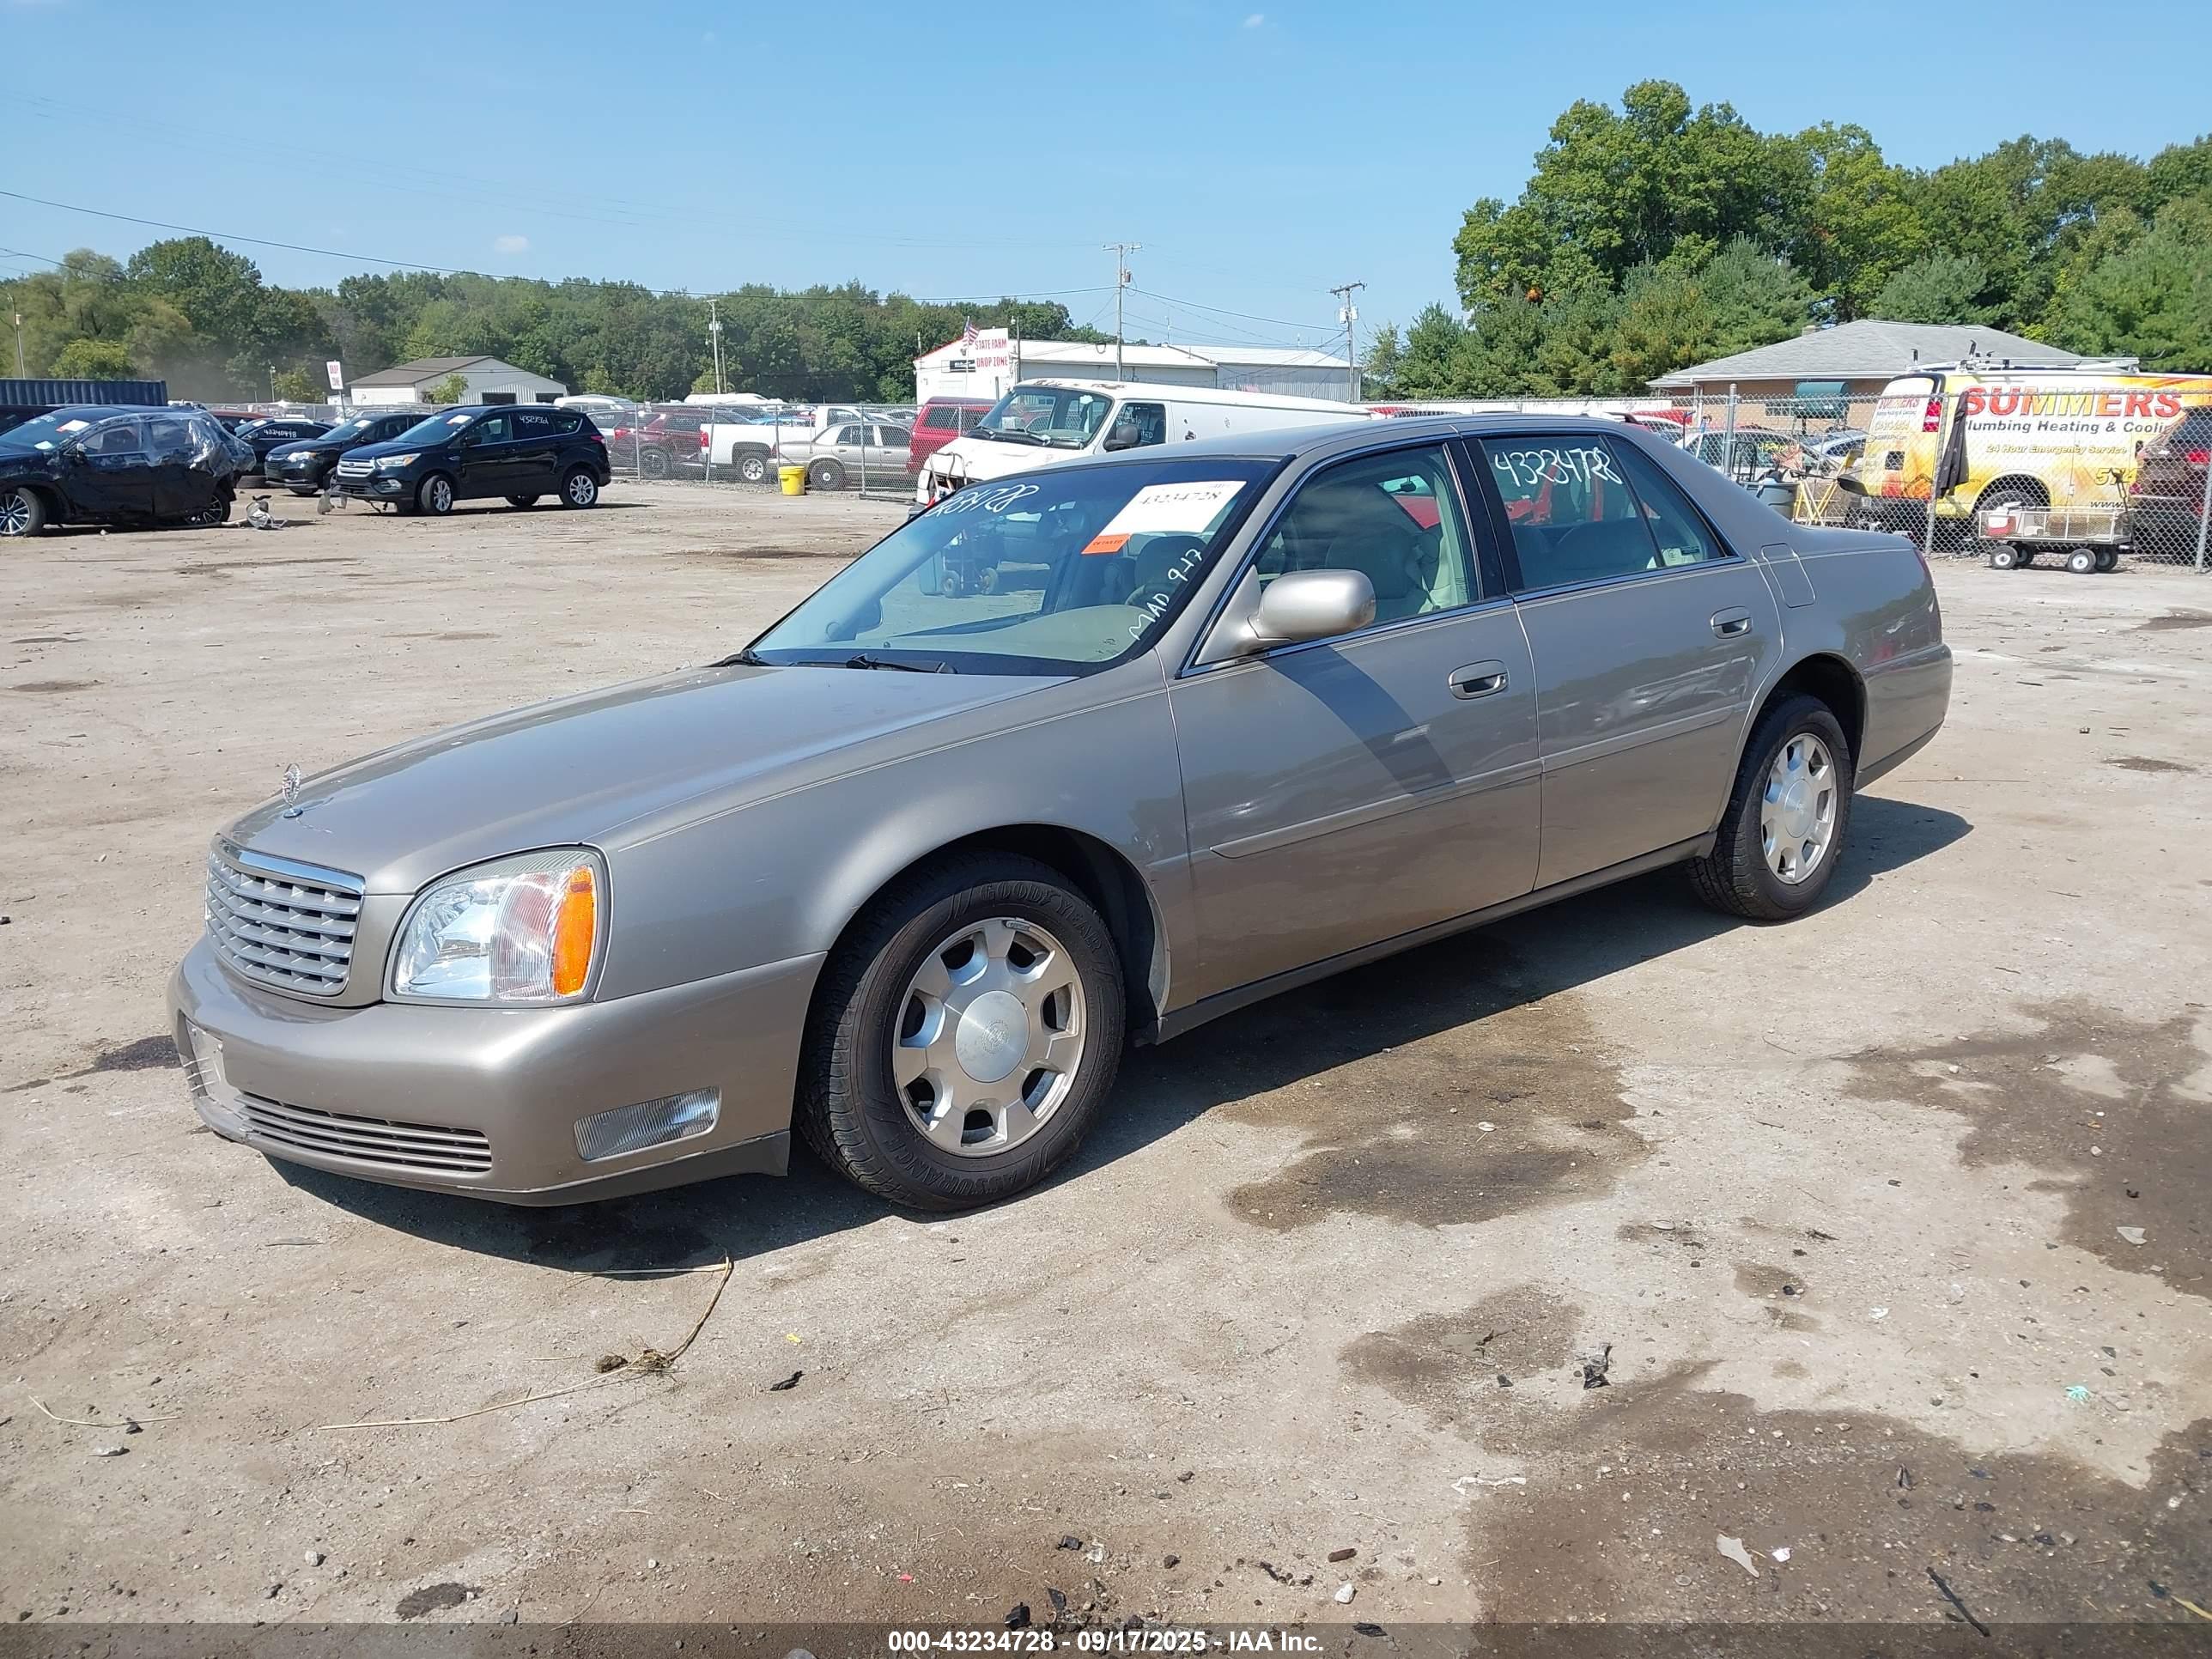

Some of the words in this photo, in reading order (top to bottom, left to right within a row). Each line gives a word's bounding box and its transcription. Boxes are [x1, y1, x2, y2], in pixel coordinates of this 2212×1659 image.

[975, 340, 991, 350] STATE
[991, 338, 1007, 349] FARM
[976, 357, 992, 368] DROP
[993, 356, 1008, 367] ZONE
[1964, 386, 2183, 418] SUMMERS
[1966, 419, 2032, 433] lumbing
[2038, 420, 2100, 434] Heating
[2106, 421, 2117, 433] &
[1985, 445, 1999, 453] 24
[2002, 445, 2027, 453] Hour
[2029, 445, 2087, 455] Emergency
[2087, 445, 2128, 454] Service
[1494, 446, 1624, 488] 43234728
[1168, 548, 1202, 582] 9-17
